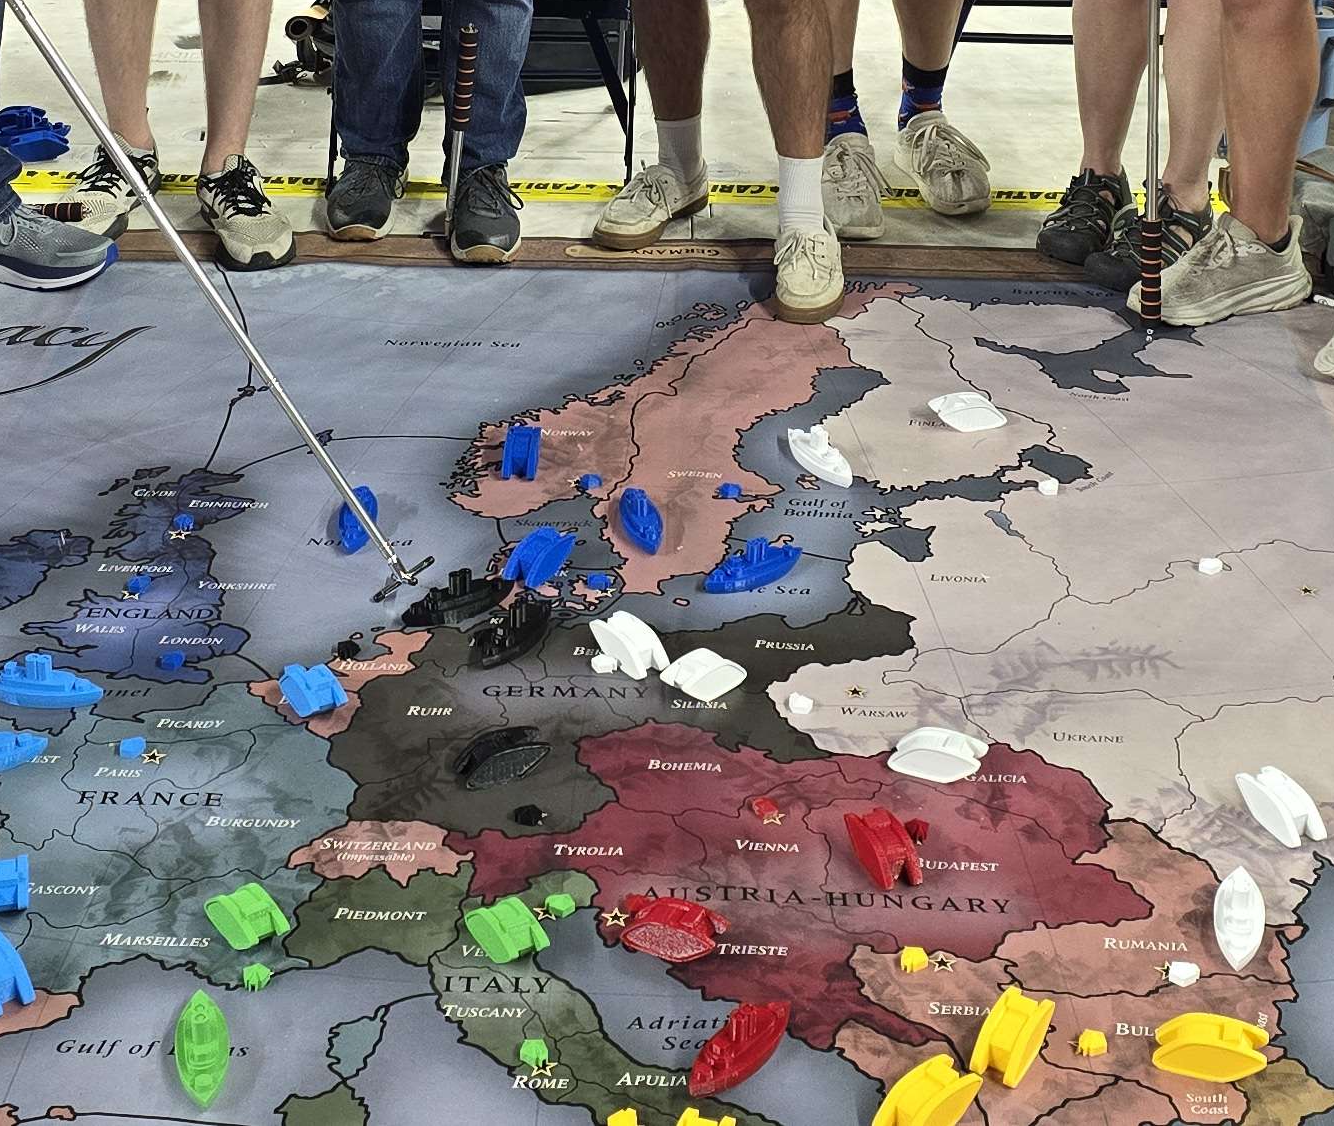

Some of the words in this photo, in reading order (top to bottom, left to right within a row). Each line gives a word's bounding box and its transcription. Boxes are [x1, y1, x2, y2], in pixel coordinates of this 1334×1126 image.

[384, 337, 484, 350] Norwegian
[490, 338, 522, 349] Sea
[908, 417, 950, 429] FINLA
[540, 427, 596, 439] NORWAY
[667, 469, 723, 481] SWEDEN
[134, 488, 178, 500] CLYDE
[188, 498, 269, 511] EDINBURGH
[788, 497, 823, 510] Gulf
[828, 497, 851, 510] of
[783, 507, 854, 520] Bothnia
[98, 562, 175, 575] LIVERPOOL
[930, 572, 988, 585] LIVONIA
[197, 580, 277, 593] YORKSHIRE
[779, 583, 812, 596] Sea
[85, 606, 221, 623] ENGLAND
[74, 622, 128, 636] WALES
[159, 634, 224, 648] LONDON
[754, 639, 816, 653] PRUSSIA
[337, 659, 412, 674] HOLLAND
[482, 684, 651, 701] GERMANY
[406, 704, 453, 718] RUHR
[670, 698, 729, 711] SILESIA
[840, 707, 908, 720] WARSAW
[156, 717, 225, 732] PICARDY
[1052, 732, 1125, 746] UKRAINE
[26, 753, 61, 765] EST
[94, 766, 143, 779] PARIS
[647, 759, 723, 774] BOHEMIA
[965, 773, 1028, 785] GALICIA
[76, 790, 224, 808] FRANCE
[205, 815, 301, 830] BURGUNDY
[320, 837, 438, 854] SWITZERLAND
[553, 843, 624, 858] TYROLIA
[735, 839, 800, 854] VIENNA
[336, 851, 416, 864] (impassable)
[917, 858, 999, 873] BUDAPEST
[26, 882, 99, 897] GASCONY
[641, 884, 1012, 915] AUSTRIA-HUNGARY
[333, 907, 427, 923] PIEDMONT
[98, 932, 211, 950] MARSEILLES
[1103, 937, 1188, 953] RUMANIA
[717, 942, 789, 958] TRIESTE
[443, 976, 554, 995] ITALY
[443, 1003, 527, 1019] TUSCANY
[928, 1001, 992, 1017] SERBIA
[627, 1015, 730, 1031] Adriati
[56, 1037, 119, 1058] Gulf
[126, 1037, 160, 1058] of
[662, 1035, 709, 1052] Sea
[512, 1074, 570, 1091] ROME
[616, 1071, 688, 1088] APULIA
[1185, 1091, 1228, 1105] South
[1190, 1104, 1229, 1117] Coast
